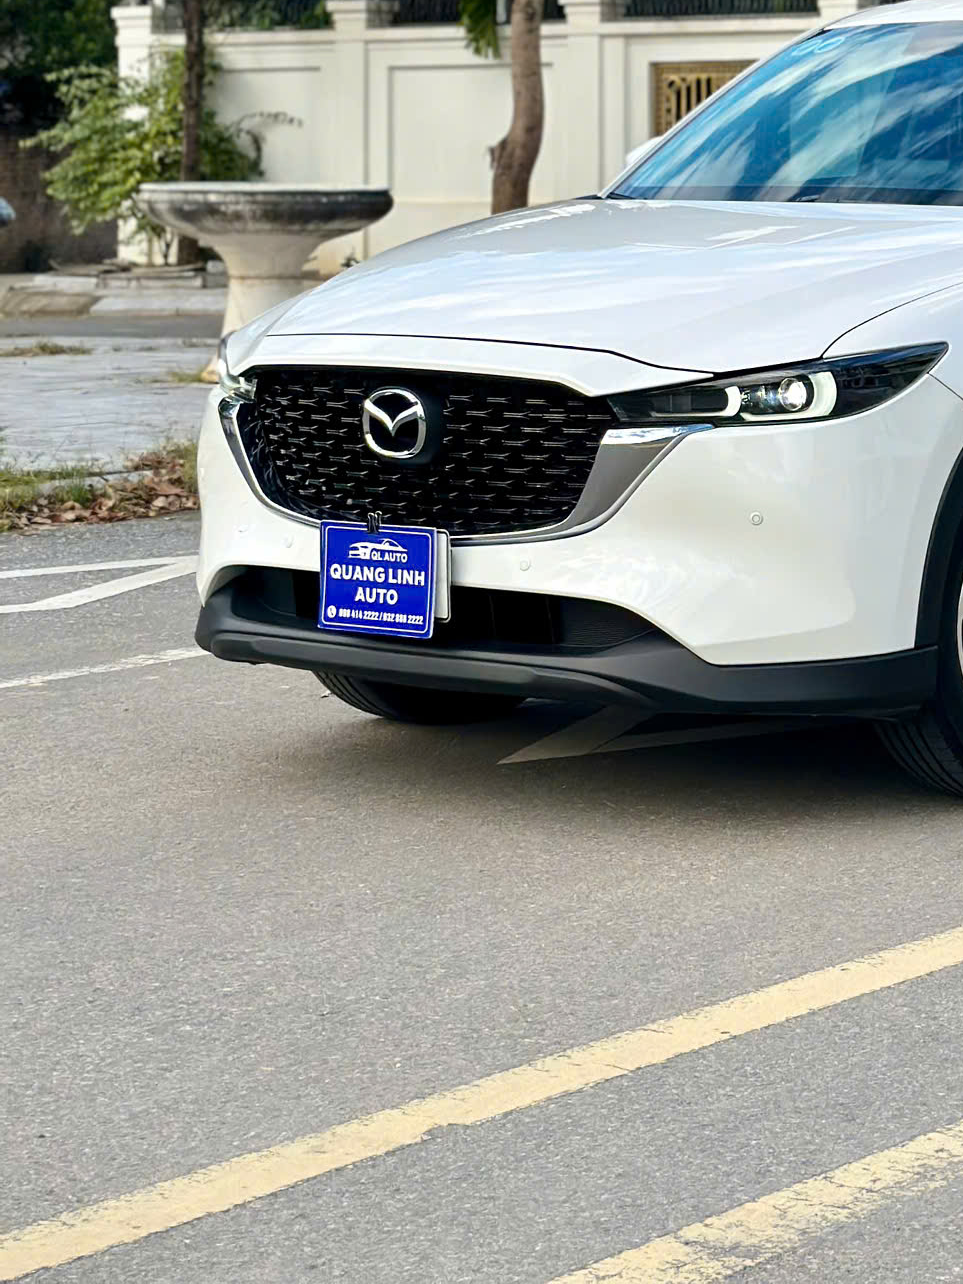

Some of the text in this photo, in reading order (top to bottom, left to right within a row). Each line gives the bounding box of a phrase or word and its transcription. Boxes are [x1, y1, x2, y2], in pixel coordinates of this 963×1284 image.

[371, 550, 408, 563] QL AUTO
[330, 564, 425, 586] QUANG LINH
[354, 586, 398, 605] AUTO
